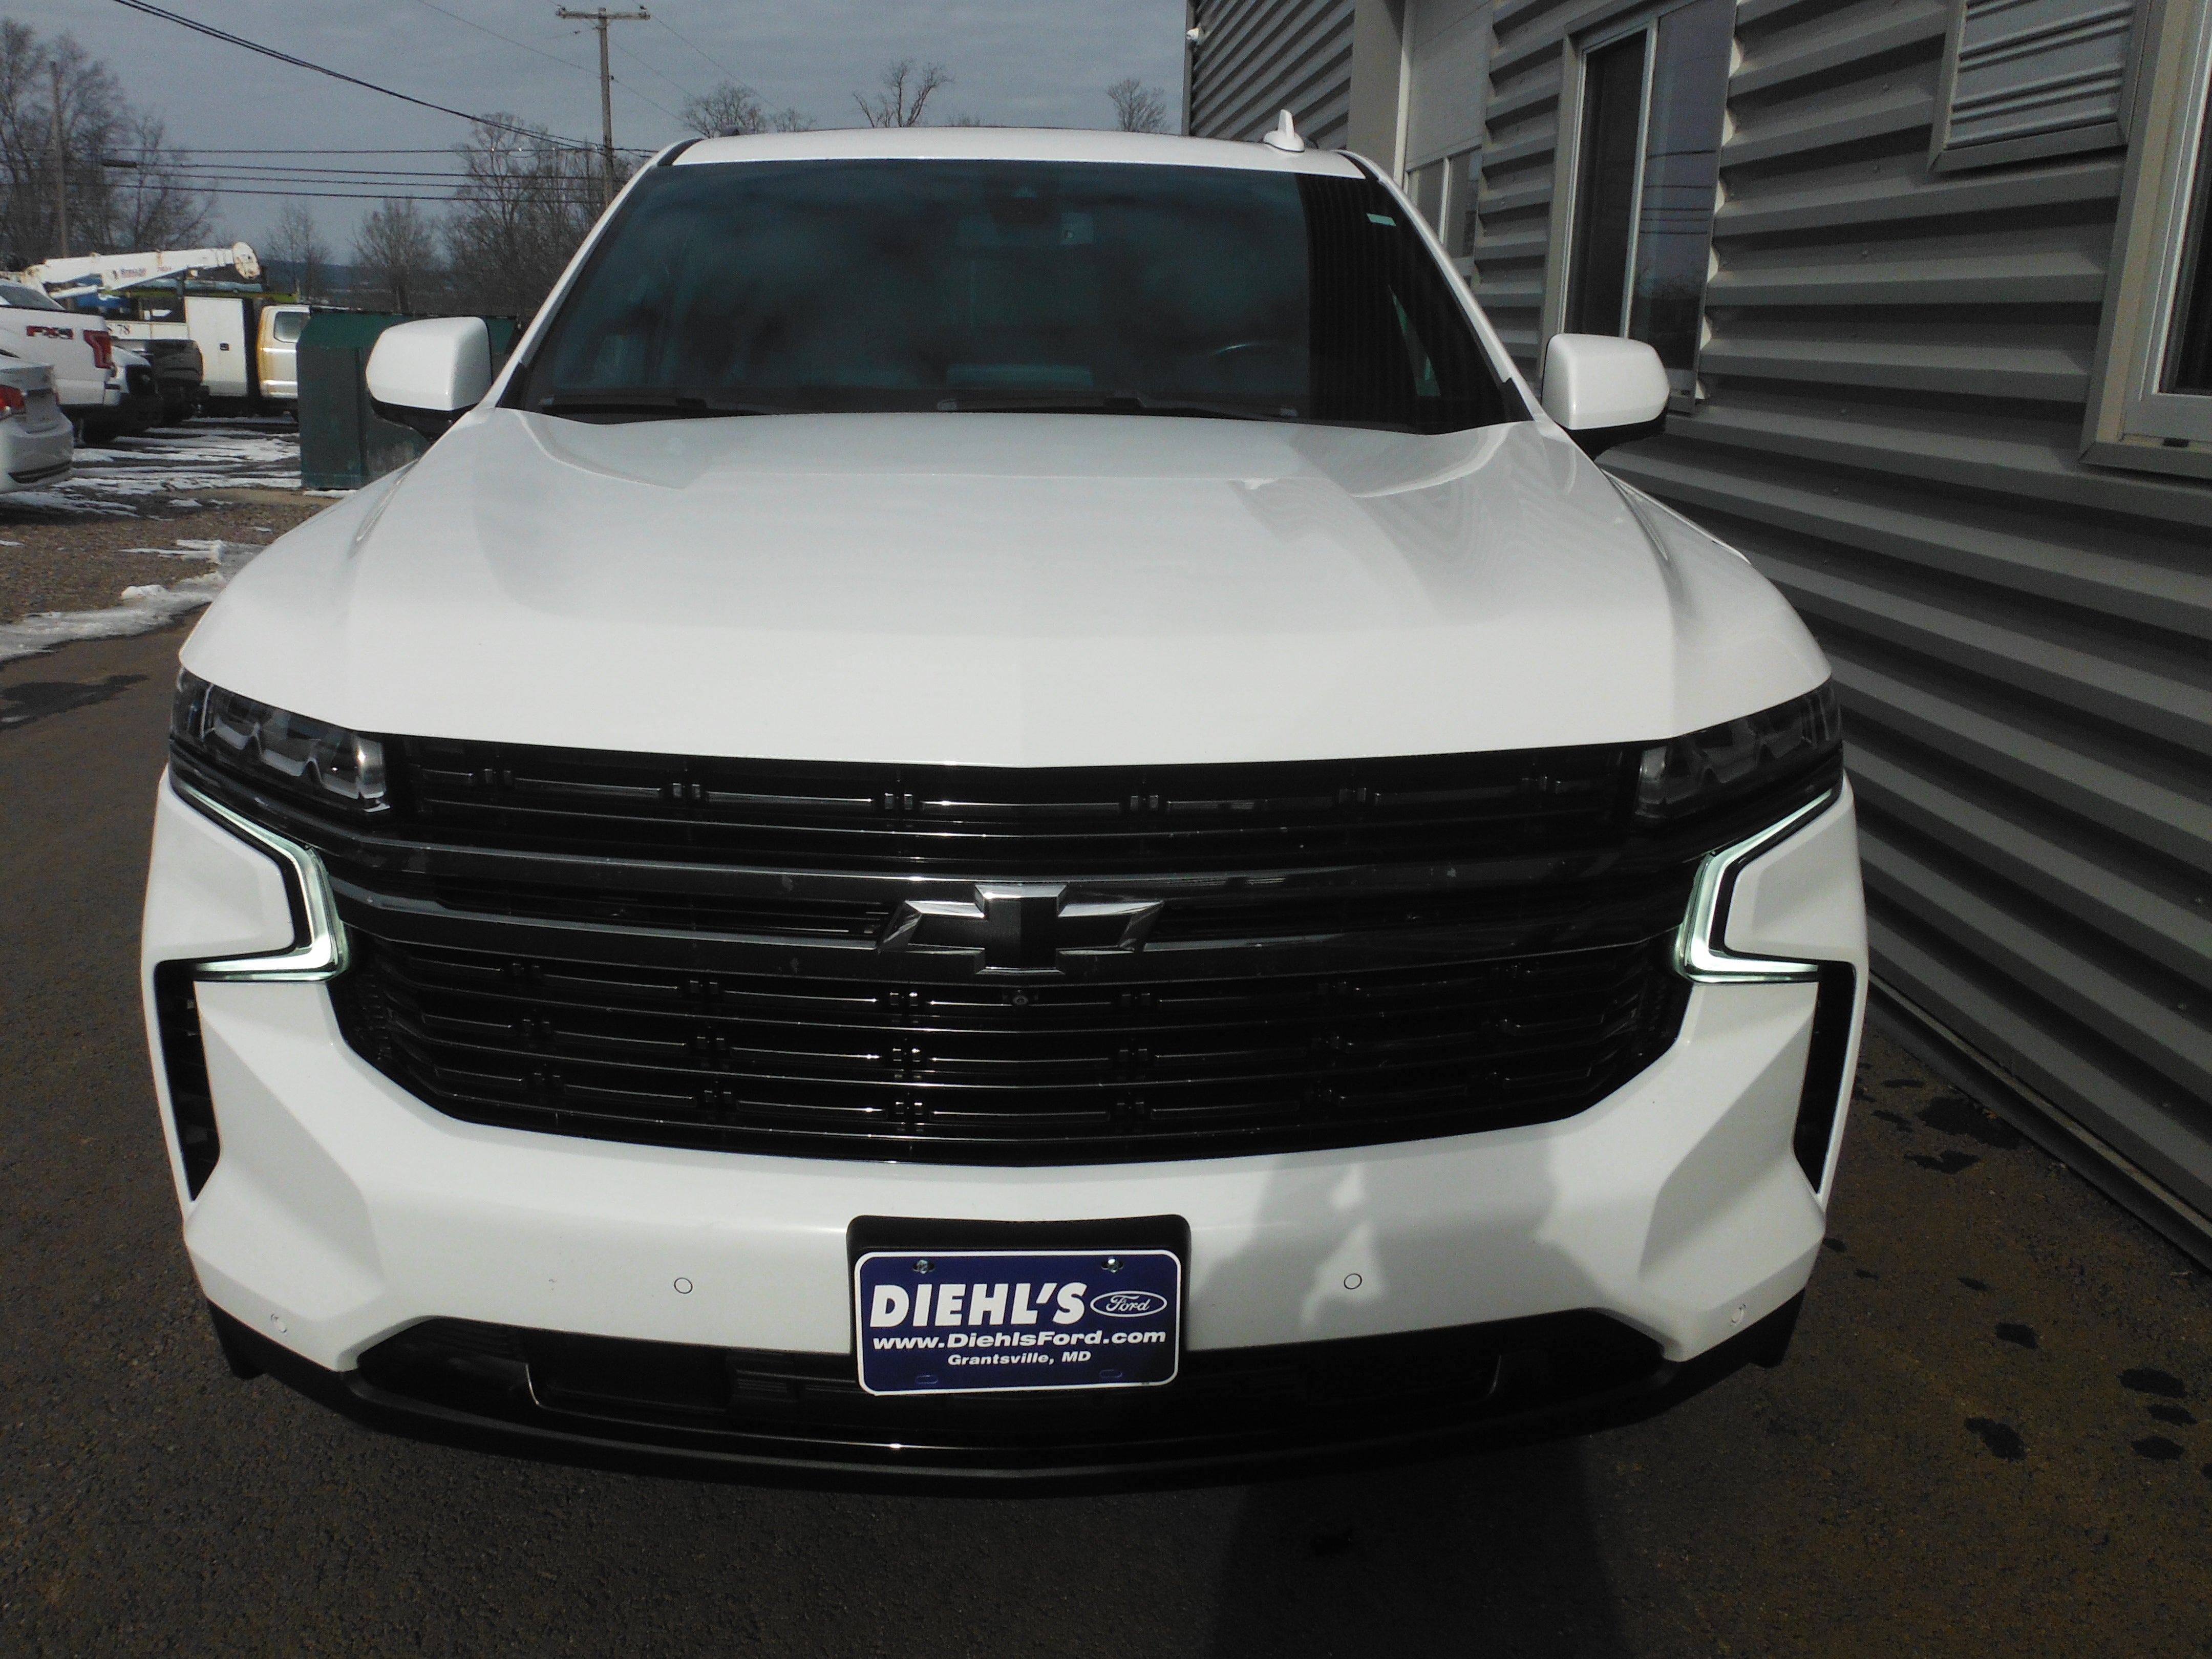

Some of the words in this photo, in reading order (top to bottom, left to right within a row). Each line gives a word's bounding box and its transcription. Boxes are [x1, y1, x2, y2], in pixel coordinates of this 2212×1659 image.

[869, 1282, 1087, 1327] DIEHL'S
[1105, 1295, 1151, 1312] Ford
[873, 1330, 1166, 1350] www.DiehlsFord.com
[947, 1352, 1054, 1366] Grantsville,
[1061, 1351, 1091, 1362] MD
